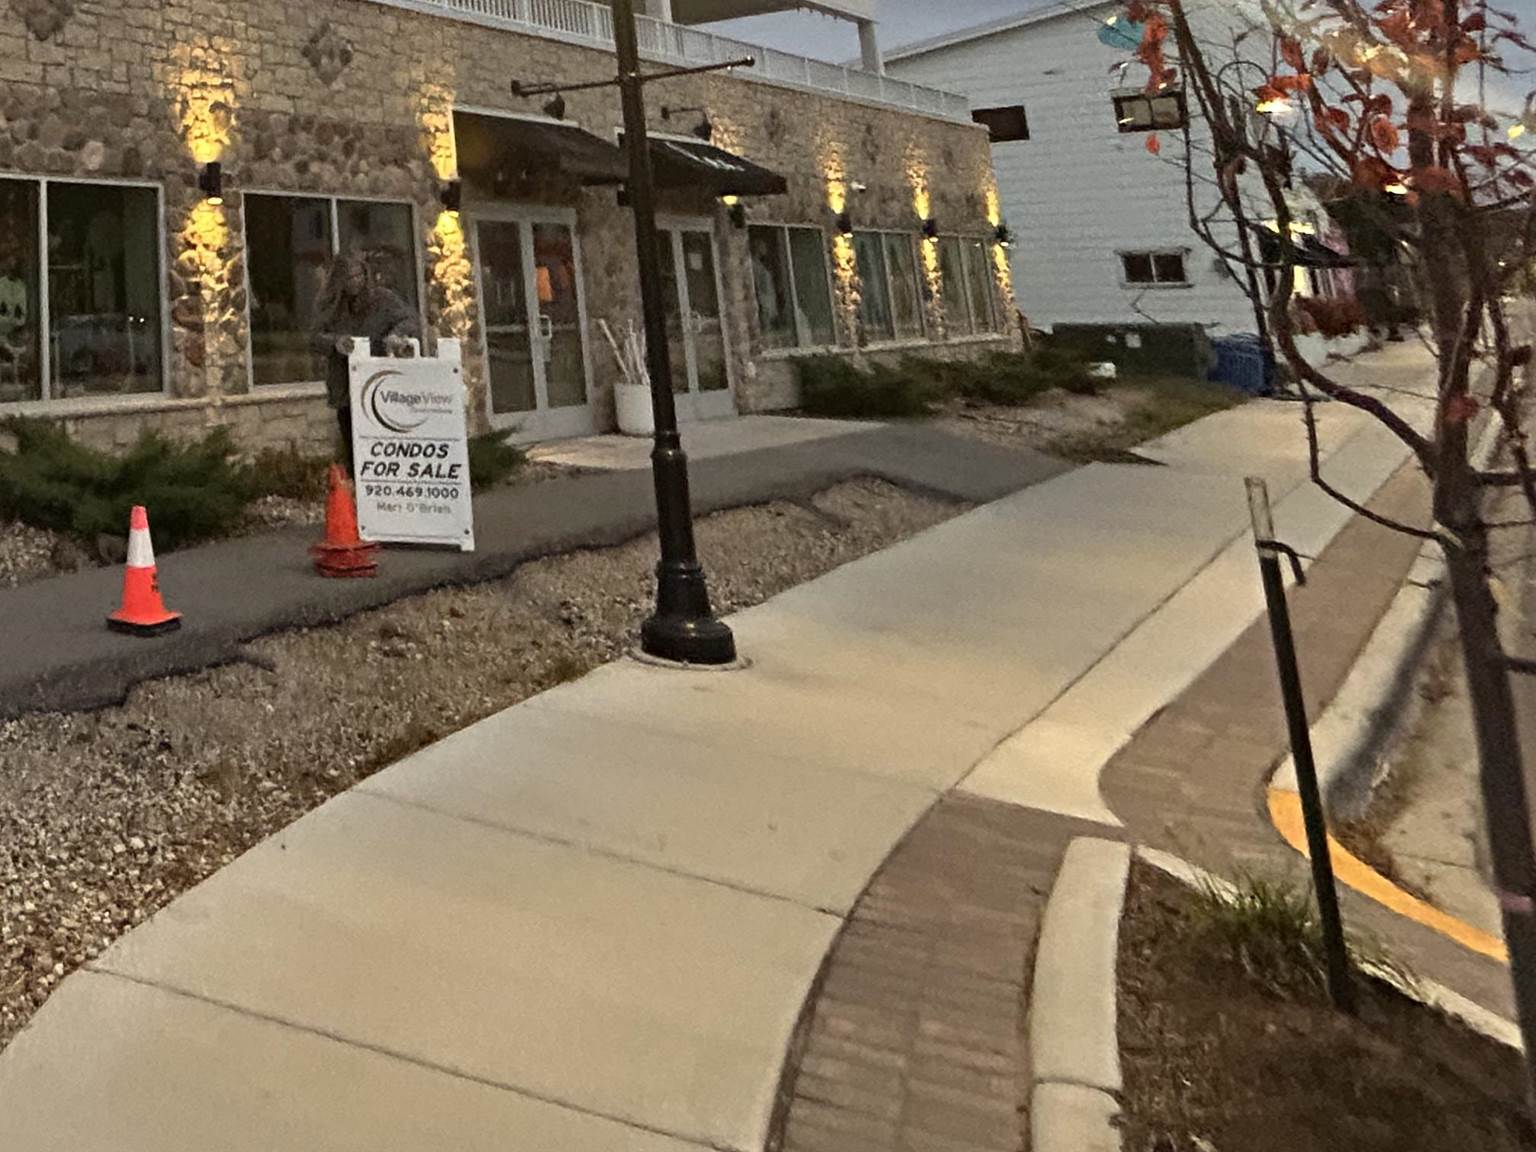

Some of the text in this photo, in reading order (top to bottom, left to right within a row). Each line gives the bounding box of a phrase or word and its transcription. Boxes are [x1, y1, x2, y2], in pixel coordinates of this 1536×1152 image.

[370, 442, 449, 459] CONDOS
[360, 461, 462, 479] FOR SALE
[365, 484, 459, 499] 920.469.1000
